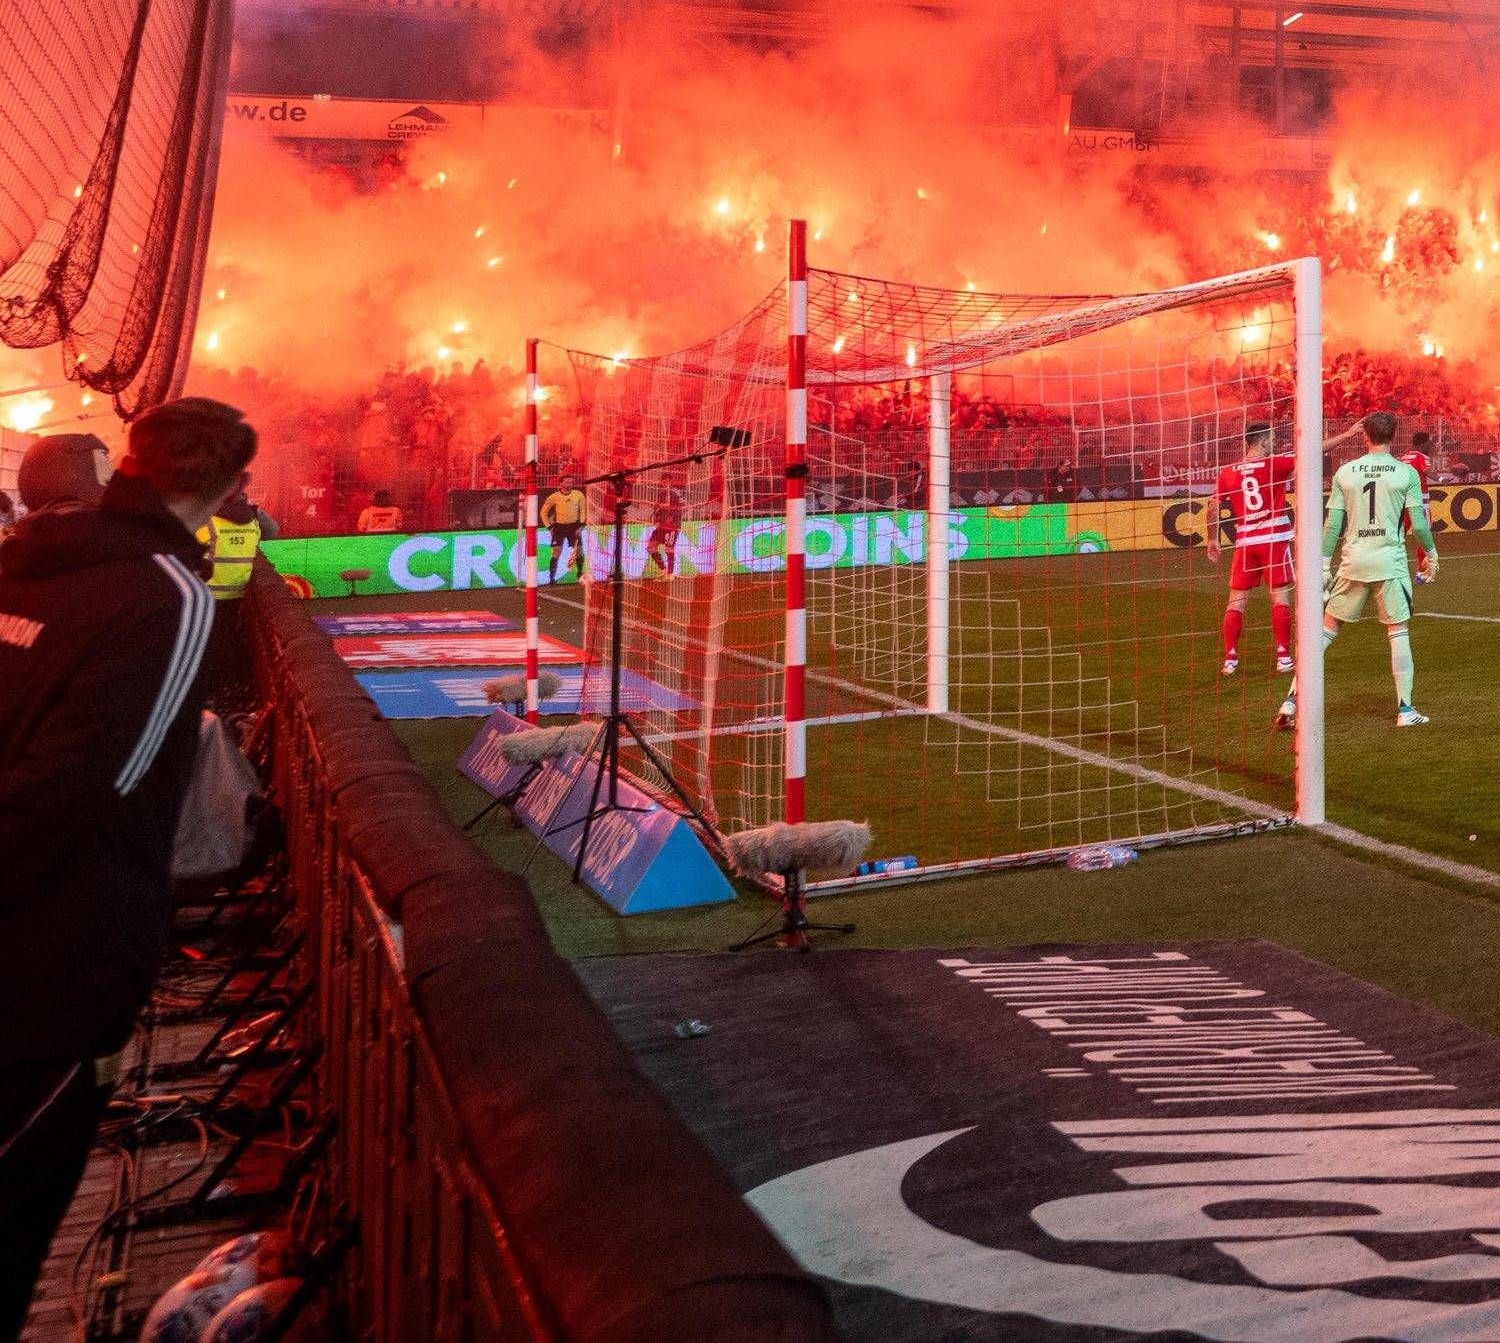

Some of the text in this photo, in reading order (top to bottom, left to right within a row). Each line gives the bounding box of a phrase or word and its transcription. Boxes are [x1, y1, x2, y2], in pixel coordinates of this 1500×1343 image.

[1359, 464, 1369, 473] FC
[1371, 464, 1396, 473] UNION
[301, 485, 326, 500] Tor
[1241, 476, 1264, 511] 8
[1362, 480, 1376, 525] 1
[305, 505, 317, 517] 4
[228, 536, 246, 546] 153
[734, 509, 970, 572] COINS
